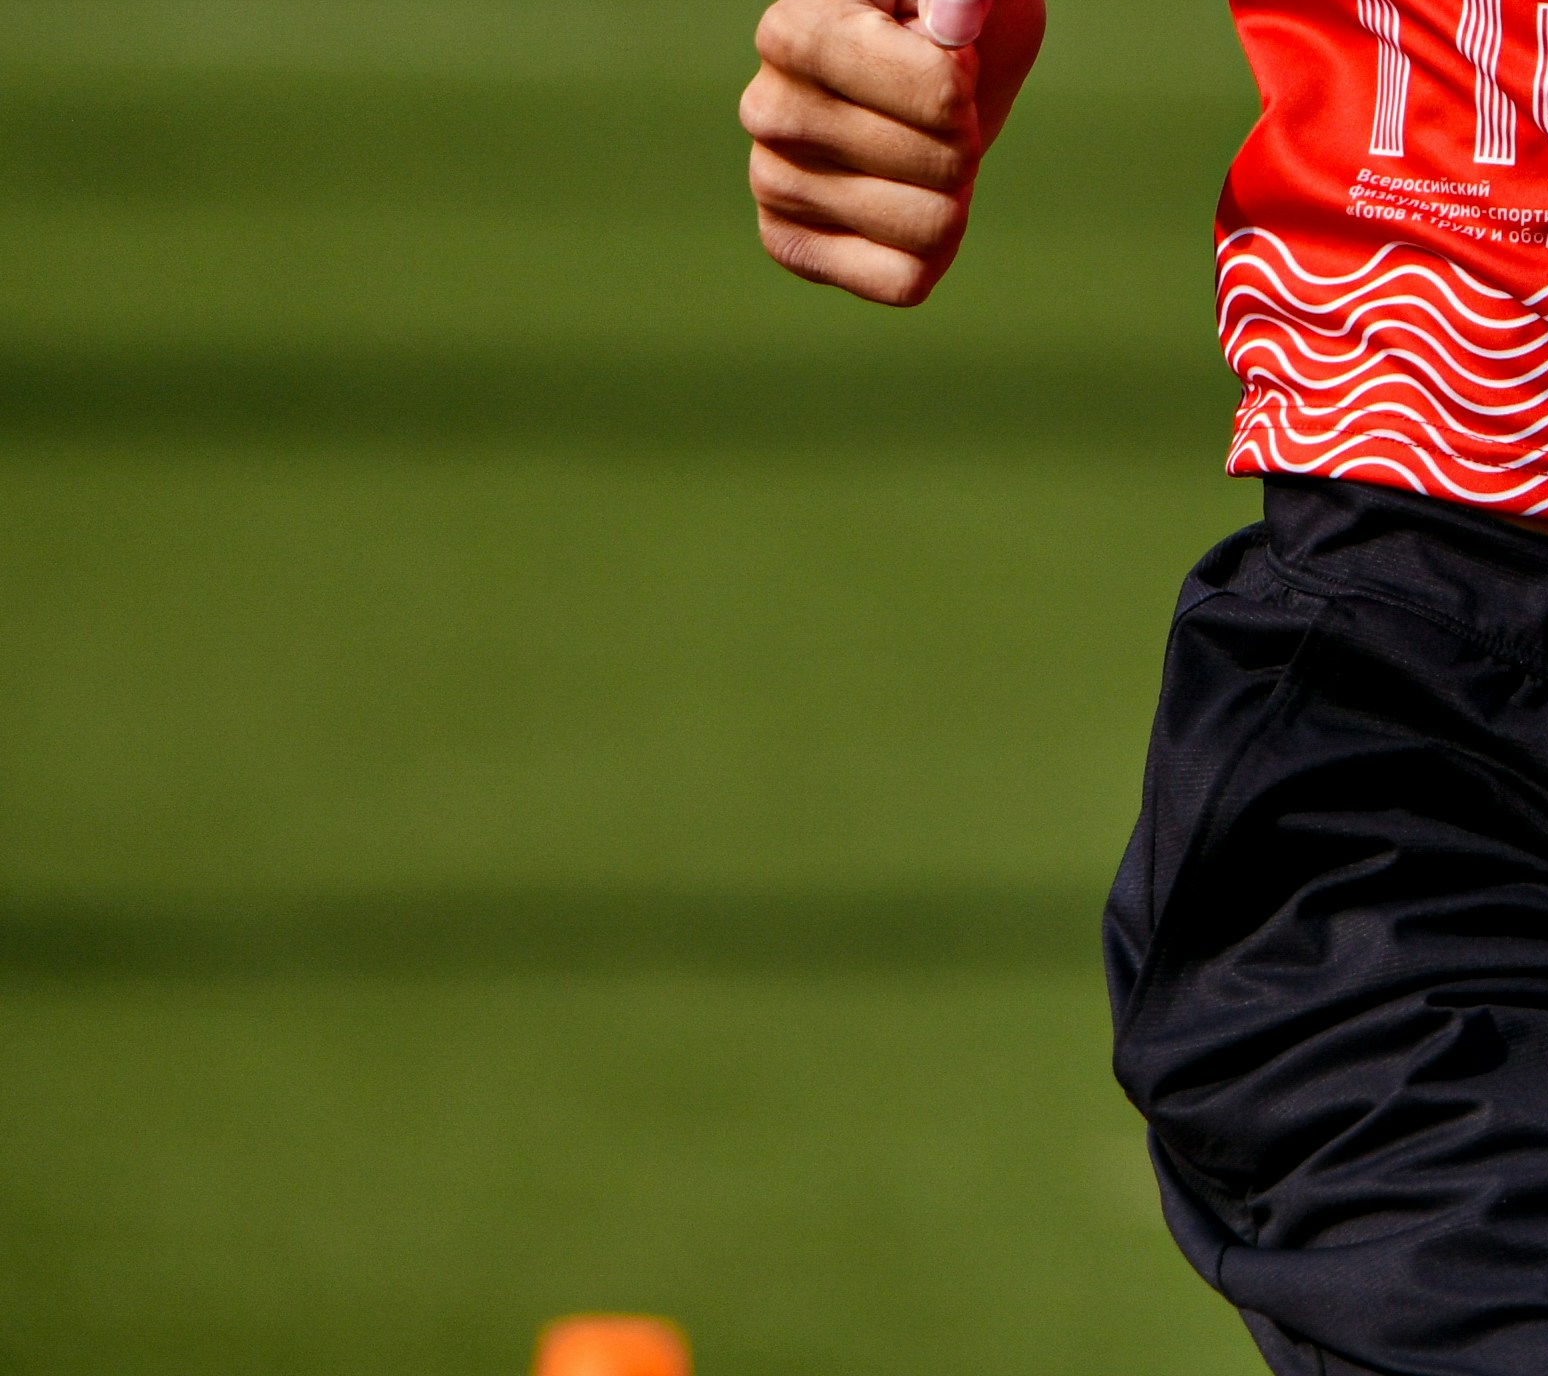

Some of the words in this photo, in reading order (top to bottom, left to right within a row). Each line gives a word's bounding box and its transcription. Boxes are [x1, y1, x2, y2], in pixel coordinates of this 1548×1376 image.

[1356, 168, 1491, 197] Всероссийский
[1346, 200, 1406, 220] «Готов
[1411, 211, 1423, 221] к
[1430, 215, 1487, 240] труду
[1491, 229, 1502, 241] и
